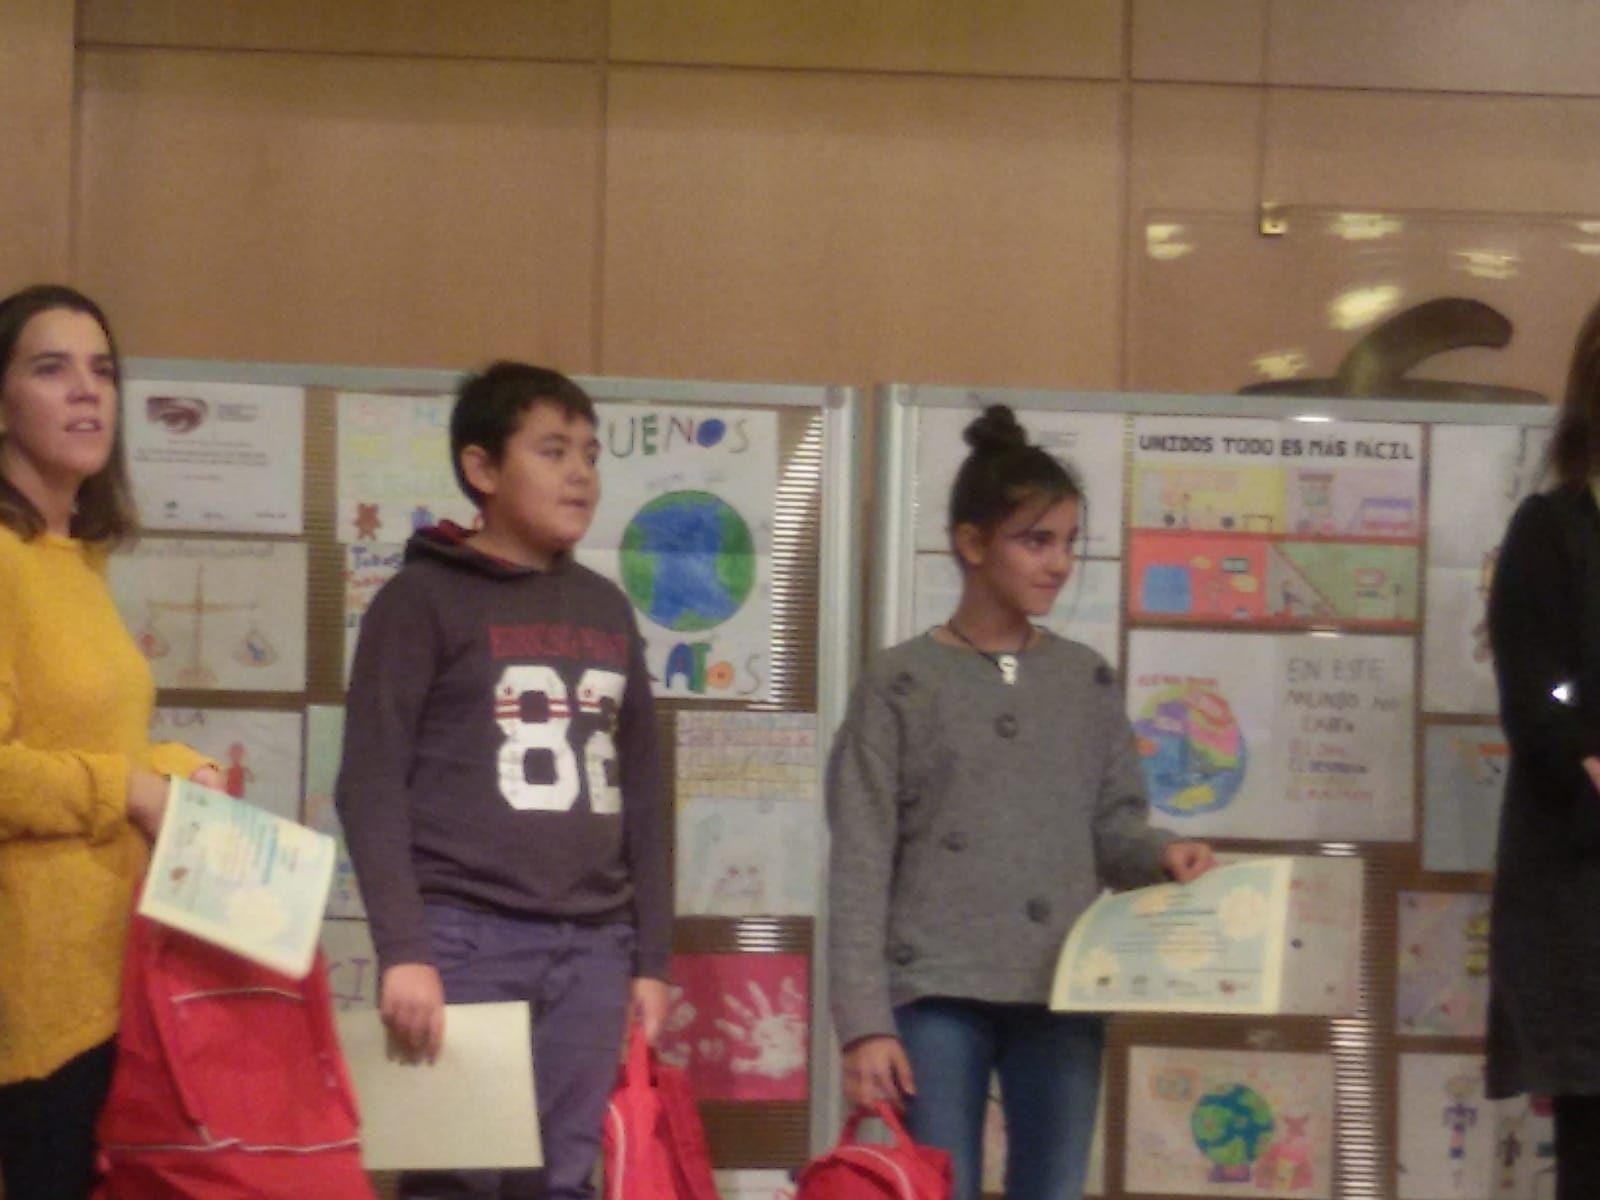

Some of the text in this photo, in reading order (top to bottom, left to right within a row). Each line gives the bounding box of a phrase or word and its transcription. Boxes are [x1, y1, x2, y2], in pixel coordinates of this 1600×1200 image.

[1139, 435, 1213, 453] UNIDOS
[1222, 437, 1273, 456] TODO
[1281, 438, 1303, 457] ES
[495, 664, 627, 815] 82
